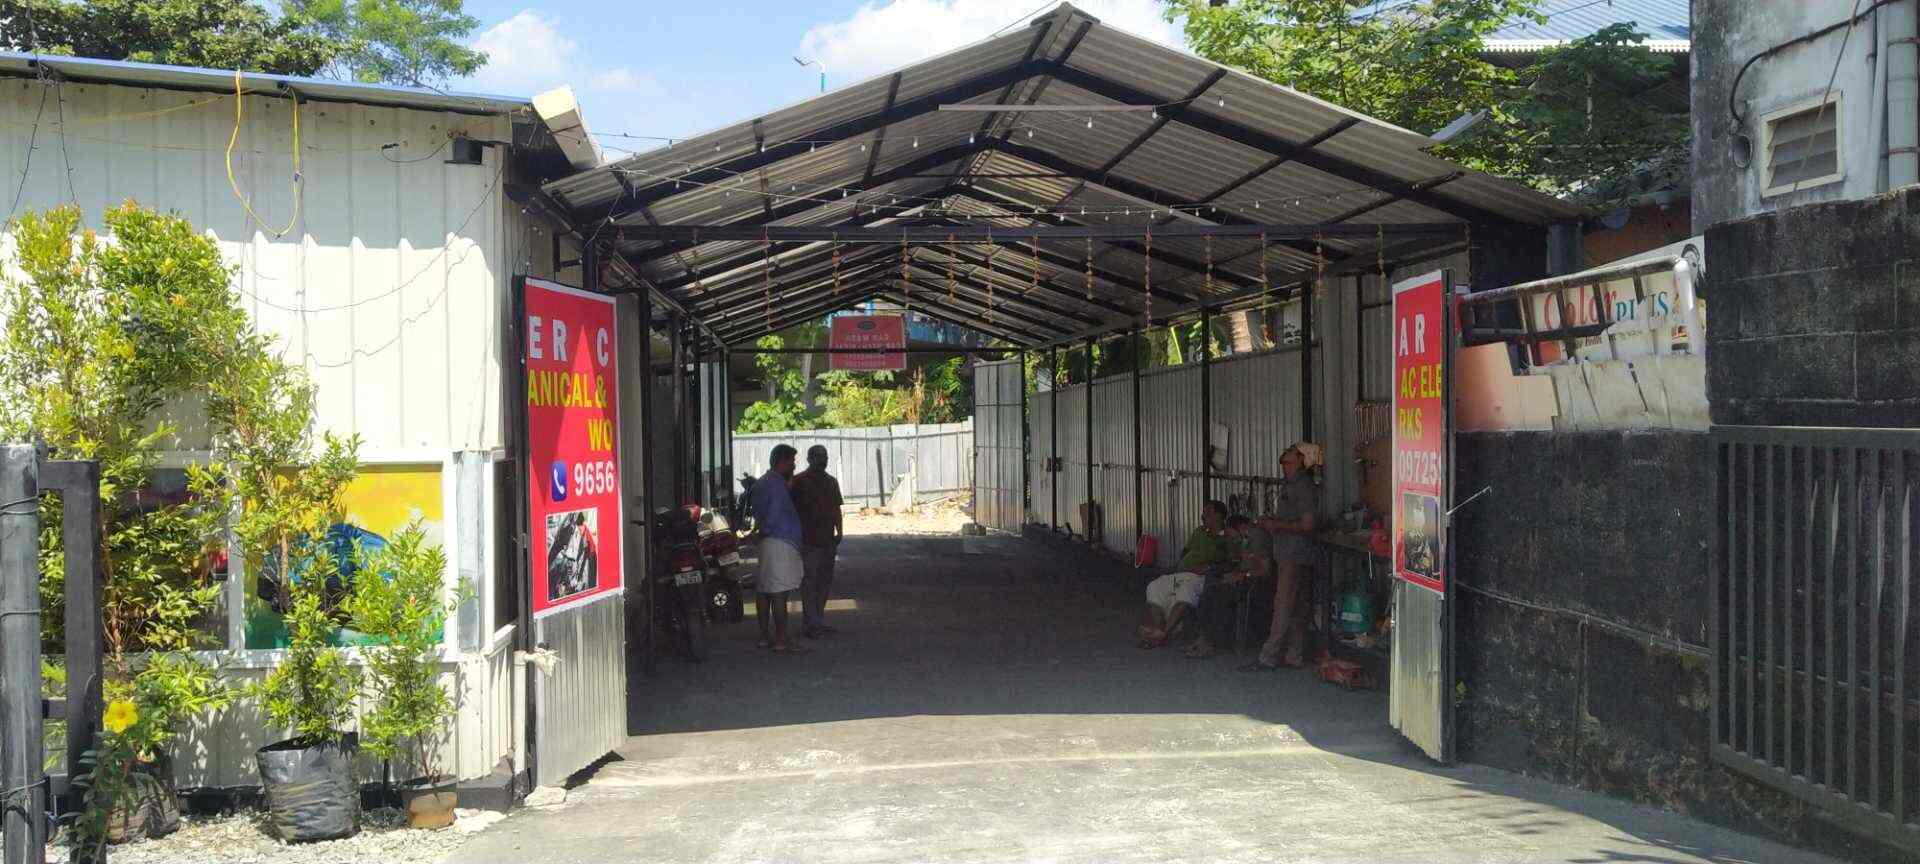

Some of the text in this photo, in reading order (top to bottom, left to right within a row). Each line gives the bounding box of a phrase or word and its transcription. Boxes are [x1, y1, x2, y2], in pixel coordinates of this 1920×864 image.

[528, 369, 592, 408] ANICAL
[1401, 367, 1416, 399] AC
[588, 417, 613, 451] WO
[1399, 407, 1424, 440] RKS
[574, 460, 614, 496] 9656
[1399, 450, 1441, 485] 09725
